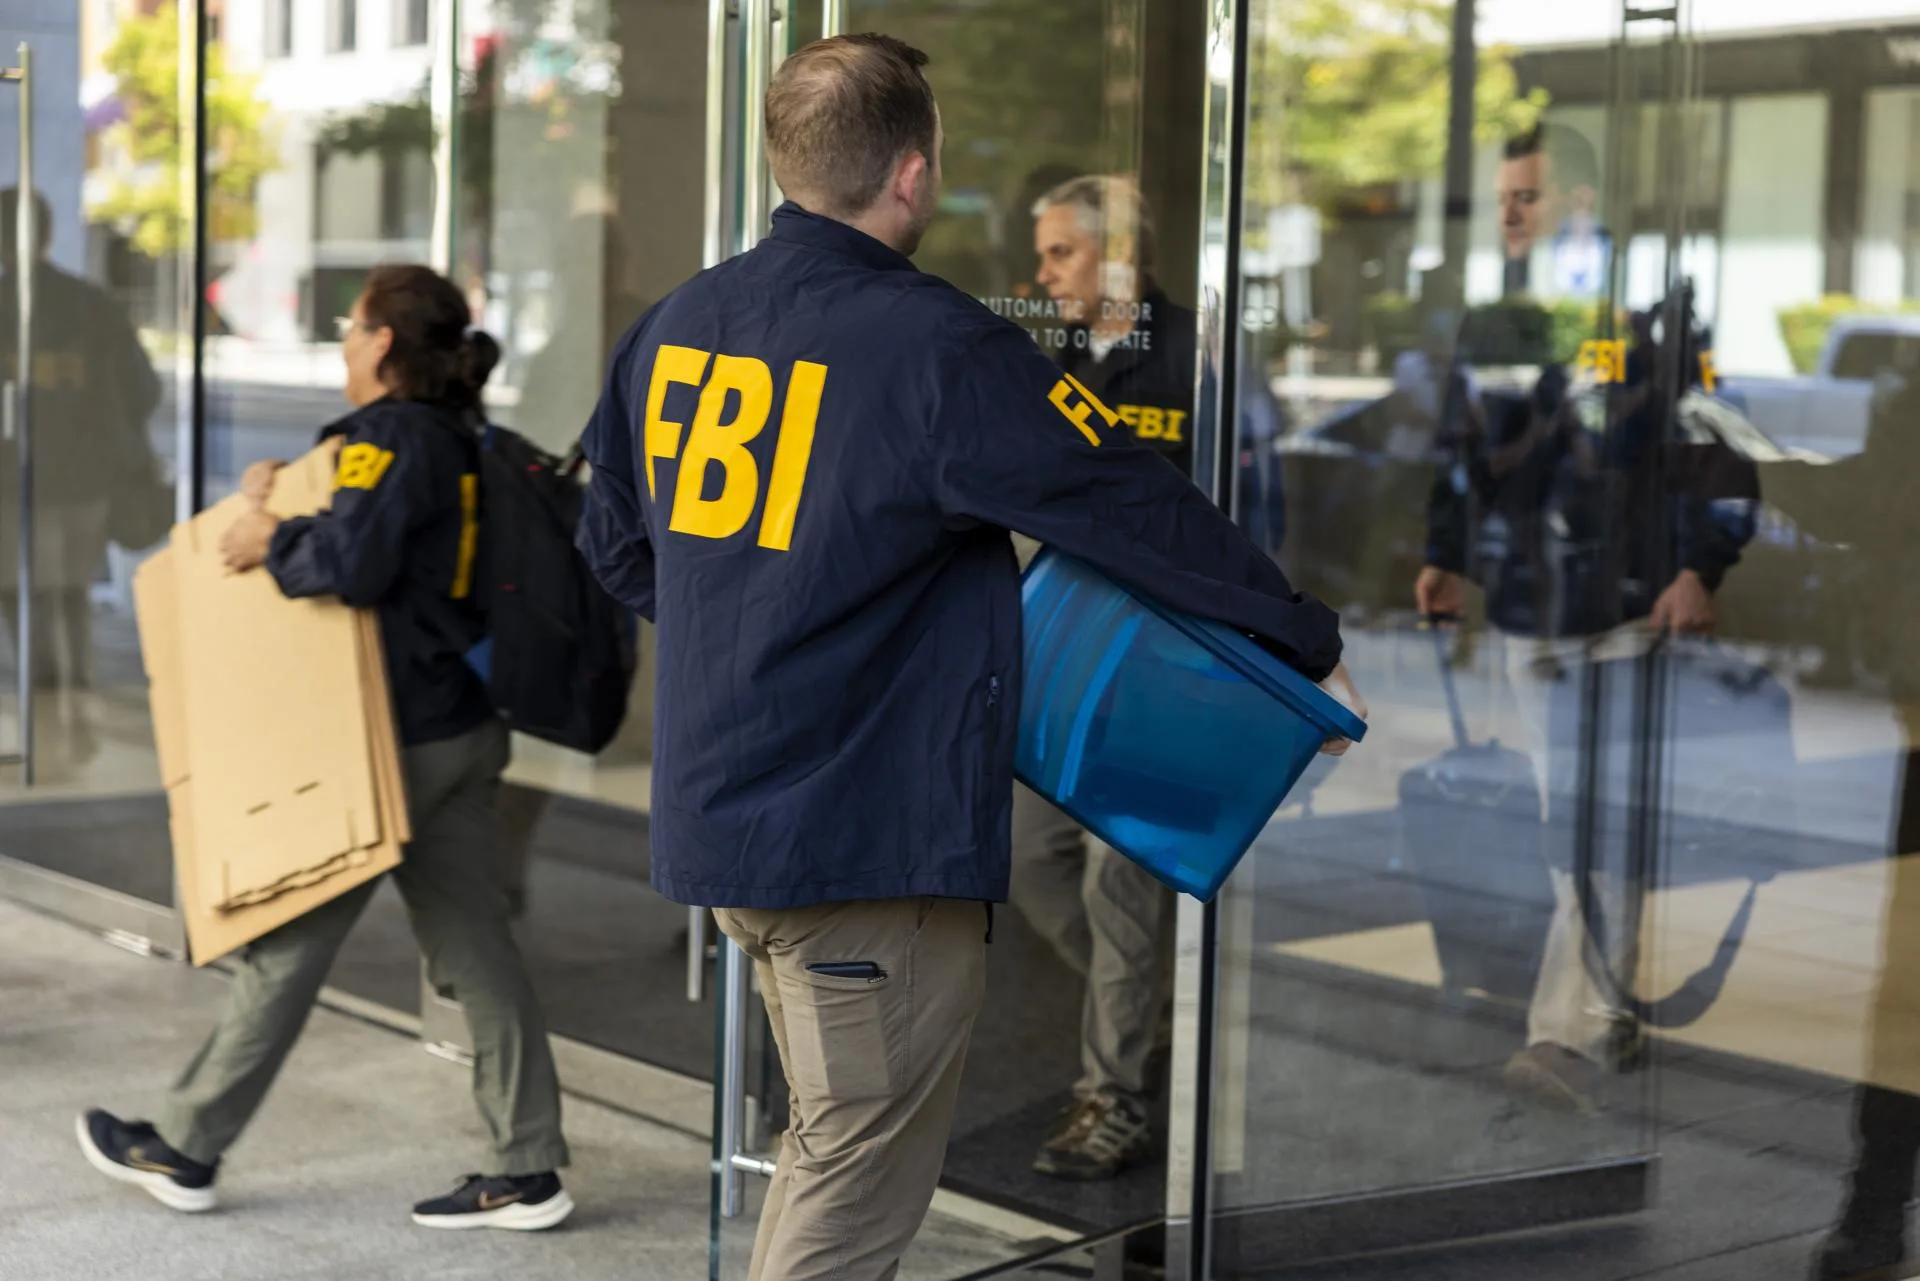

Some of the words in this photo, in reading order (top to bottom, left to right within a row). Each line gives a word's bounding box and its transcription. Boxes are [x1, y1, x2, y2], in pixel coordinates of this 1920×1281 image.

[1102, 301, 1152, 321] DOOR
[1044, 328, 1067, 349] TO
[1073, 328, 1152, 350] OATE
[1116, 403, 1187, 441] FBI
[335, 441, 395, 490] BI
[644, 344, 828, 551] FBI
